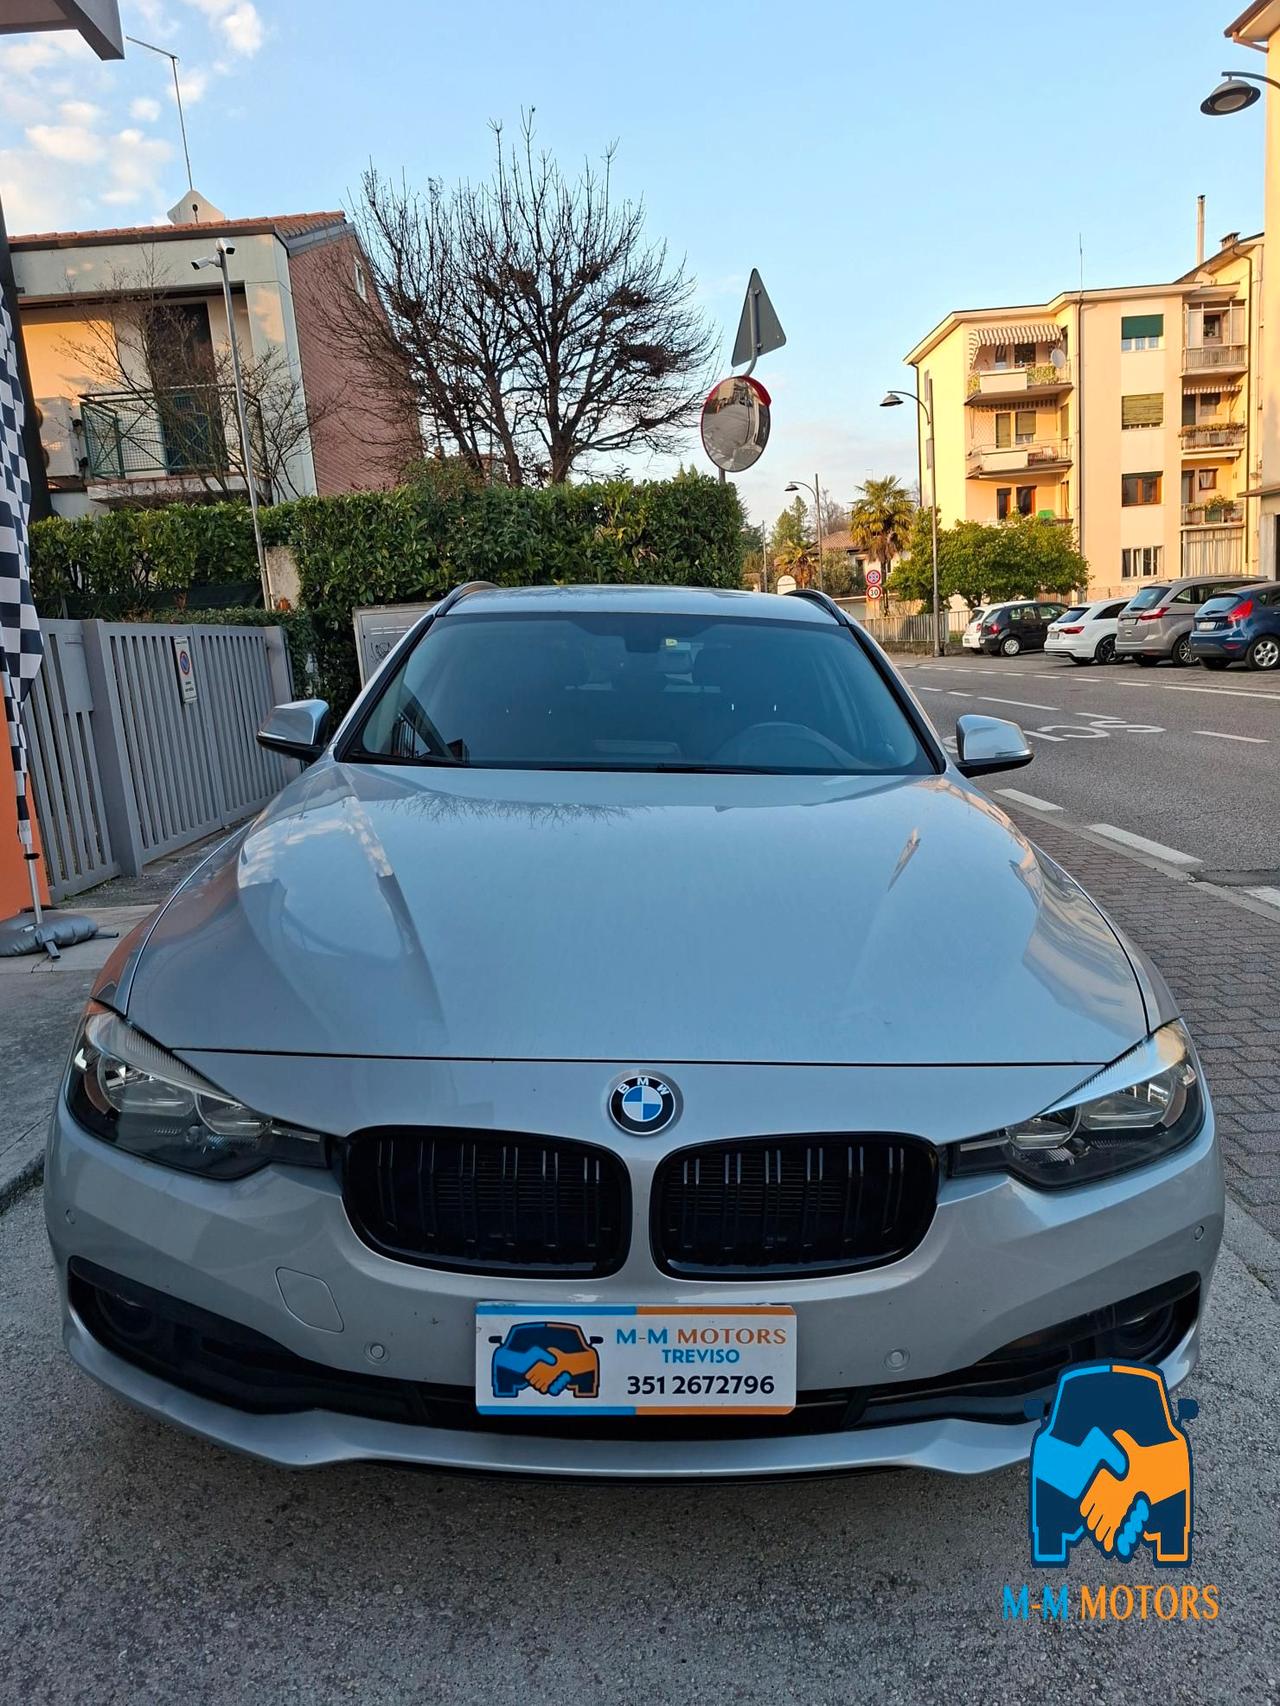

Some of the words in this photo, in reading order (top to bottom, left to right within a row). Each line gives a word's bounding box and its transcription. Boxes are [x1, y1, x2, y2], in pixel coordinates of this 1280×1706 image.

[617, 1077, 669, 1095] BMW
[615, 1328, 668, 1345] M-M
[677, 1328, 787, 1345] MOTORS
[662, 1348, 740, 1364] TREVISO
[626, 1374, 665, 1395] 351
[671, 1374, 775, 1395] 2672796
